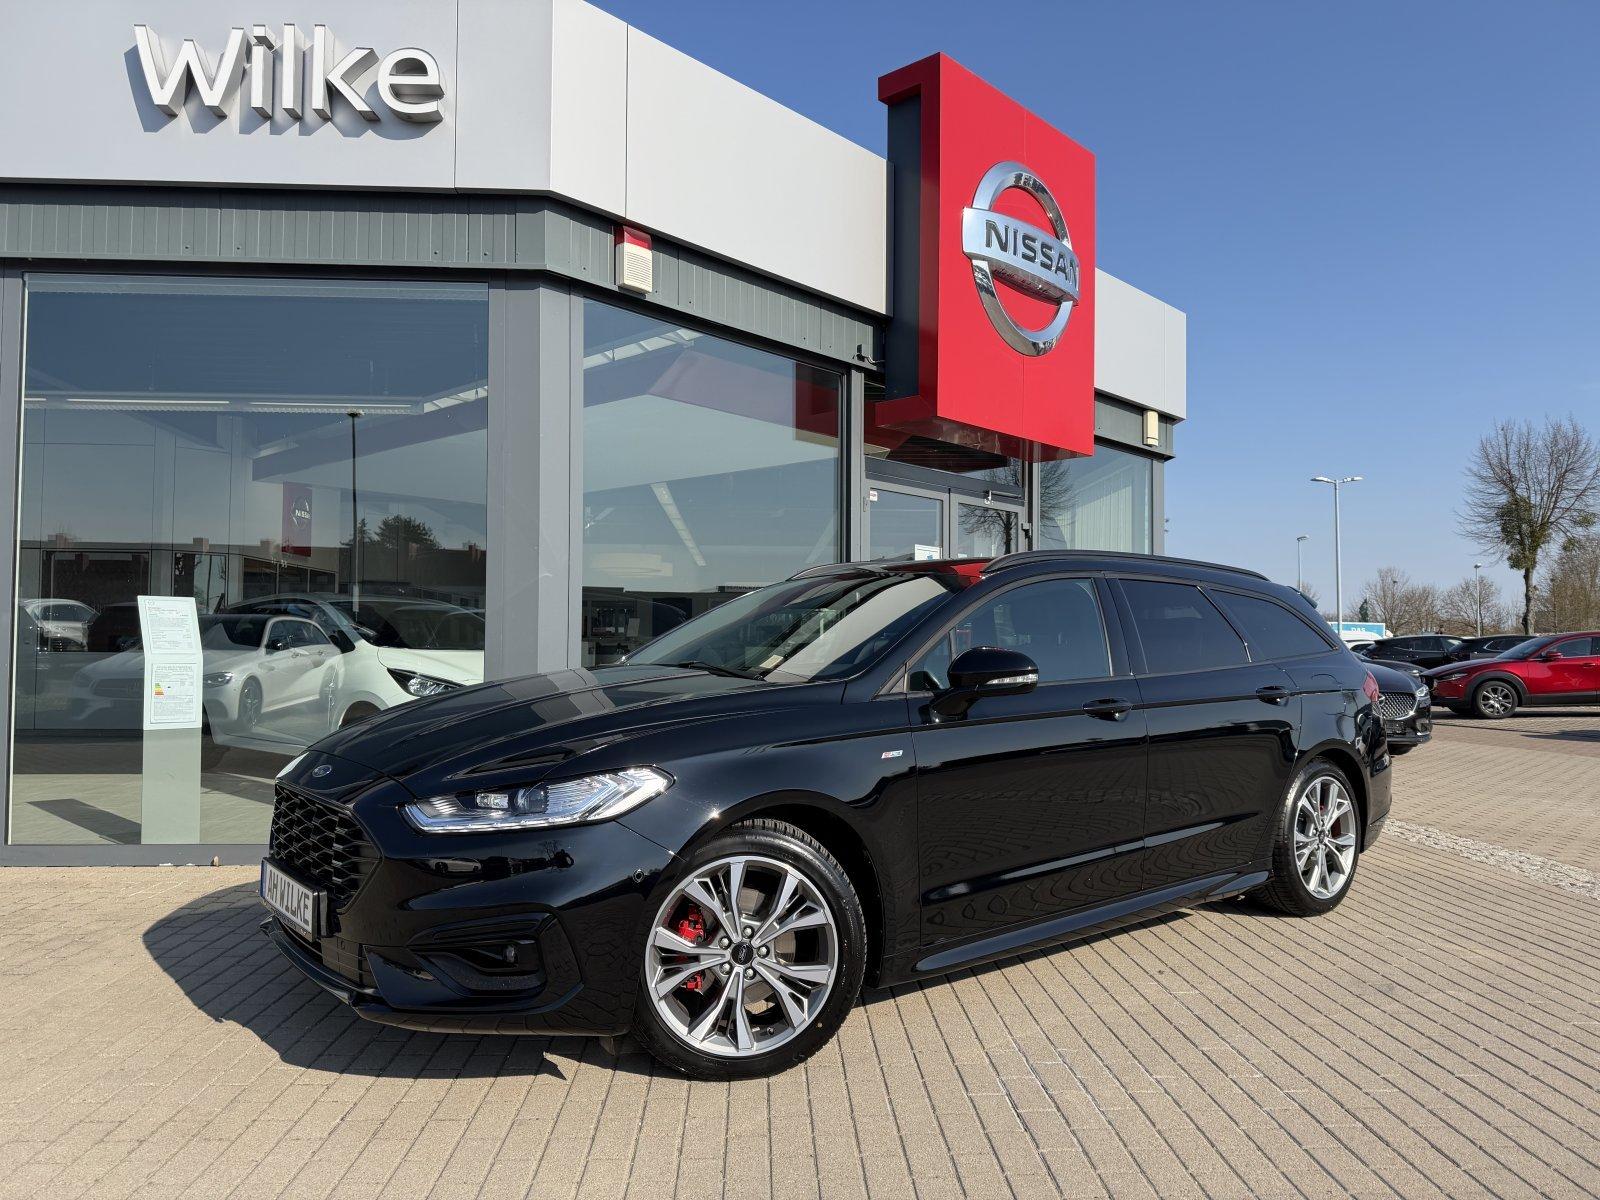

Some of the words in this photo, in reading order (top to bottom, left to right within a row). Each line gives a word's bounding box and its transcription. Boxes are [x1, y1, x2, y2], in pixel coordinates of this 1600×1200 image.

[134, 23, 444, 122] Wilke
[985, 219, 1078, 290] NISSAN
[267, 869, 279, 903] AH
[280, 877, 310, 926] WILKE
